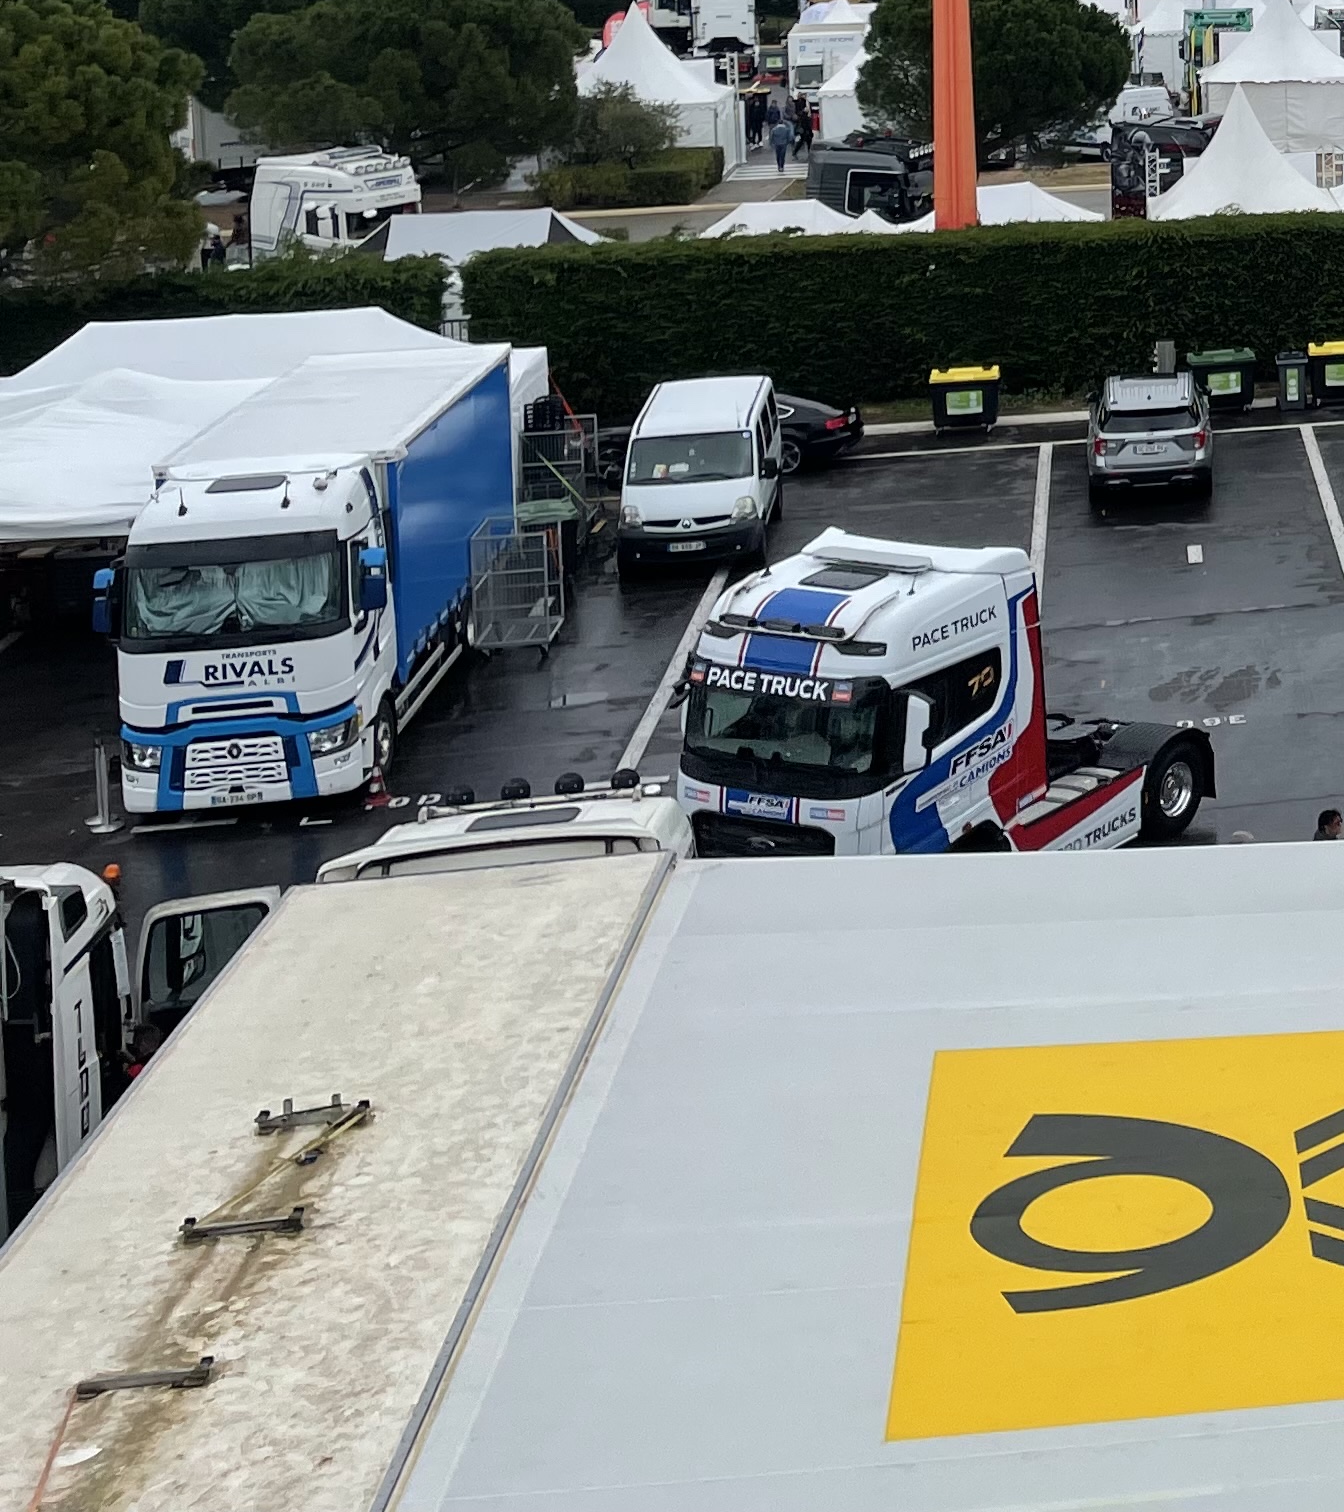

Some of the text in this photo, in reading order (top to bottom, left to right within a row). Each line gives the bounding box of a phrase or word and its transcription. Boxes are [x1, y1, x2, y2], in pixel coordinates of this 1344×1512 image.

[912, 606, 997, 652] PACE TRUCK
[204, 657, 295, 682] RIVALS
[706, 666, 830, 701] PACE TRUCK
[951, 726, 1007, 775] FFSA
[959, 747, 1011, 789] CAMIONS
[749, 795, 784, 808] FFSA
[1085, 807, 1136, 848] TRUCKS
